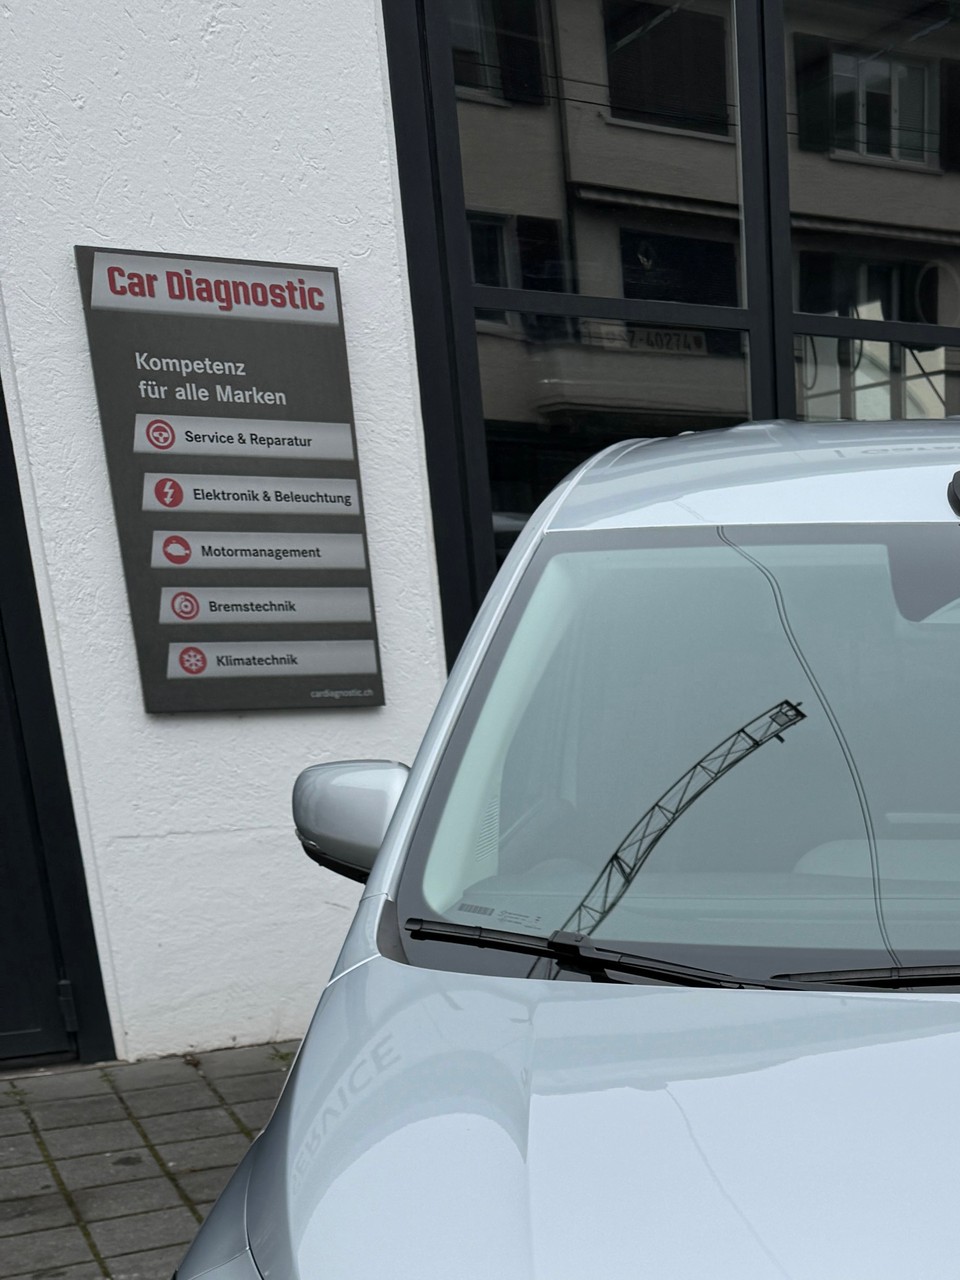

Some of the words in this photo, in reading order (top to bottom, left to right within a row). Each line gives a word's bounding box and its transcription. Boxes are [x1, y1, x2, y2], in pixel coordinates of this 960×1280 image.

[107, 266, 158, 298] Car
[166, 269, 325, 312] Diagnostic
[135, 352, 246, 377] Kompetenz
[139, 380, 168, 400] für
[175, 383, 209, 401] alle
[216, 384, 287, 405] Marken
[185, 430, 235, 445] Service
[238, 433, 247, 444] &
[250, 433, 313, 448] Reparatur
[193, 488, 260, 503] Elektronik
[263, 491, 271, 502] &
[275, 491, 353, 507] Beleuchtung
[201, 545, 322, 560] Motormanagement
[209, 600, 297, 613] Bremstechnik
[216, 655, 299, 668] Klimatechnik
